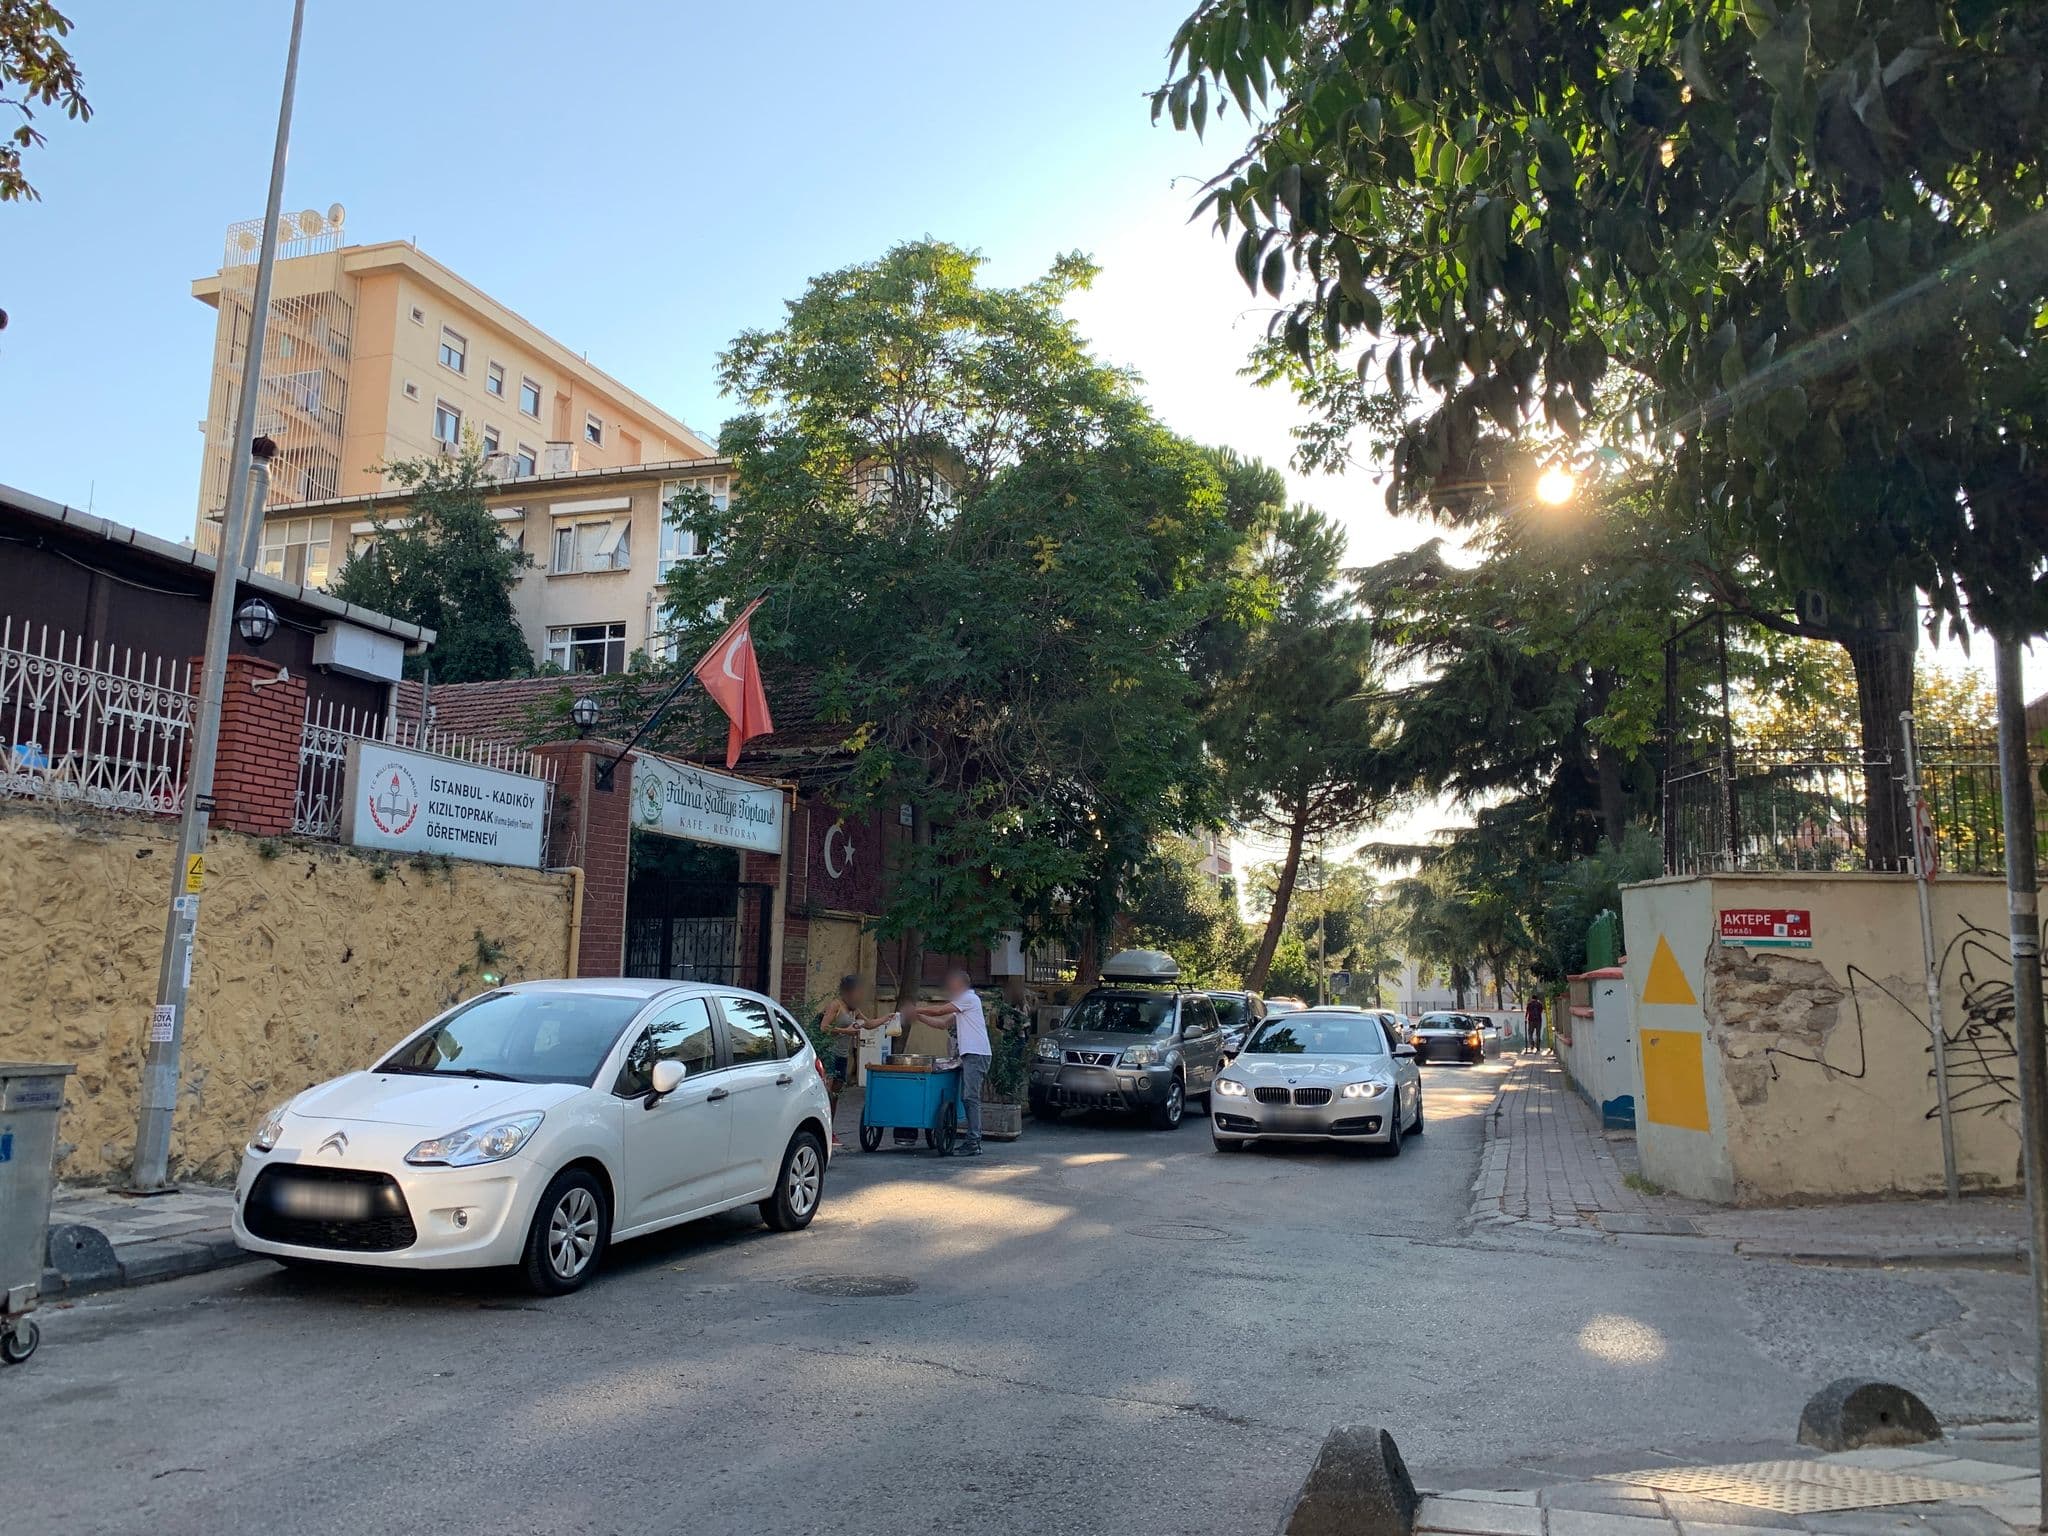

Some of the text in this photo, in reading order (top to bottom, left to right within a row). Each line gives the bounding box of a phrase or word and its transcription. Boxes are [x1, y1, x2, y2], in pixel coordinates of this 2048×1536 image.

[430, 776, 482, 800] İSTANBUL
[493, 790, 535, 809] KADIKÖY
[667, 778, 702, 809] Fatma
[704, 788, 737, 823] Şadiye
[428, 801, 494, 824] KIZILTOPRAK
[427, 821, 498, 846] ÖĞRETMENEVİ
[680, 817, 703, 831] KAFE
[713, 824, 757, 840] RESTORAN
[1724, 914, 1771, 925] AKTEPE
[1724, 927, 1752, 935] SOKAĞI
